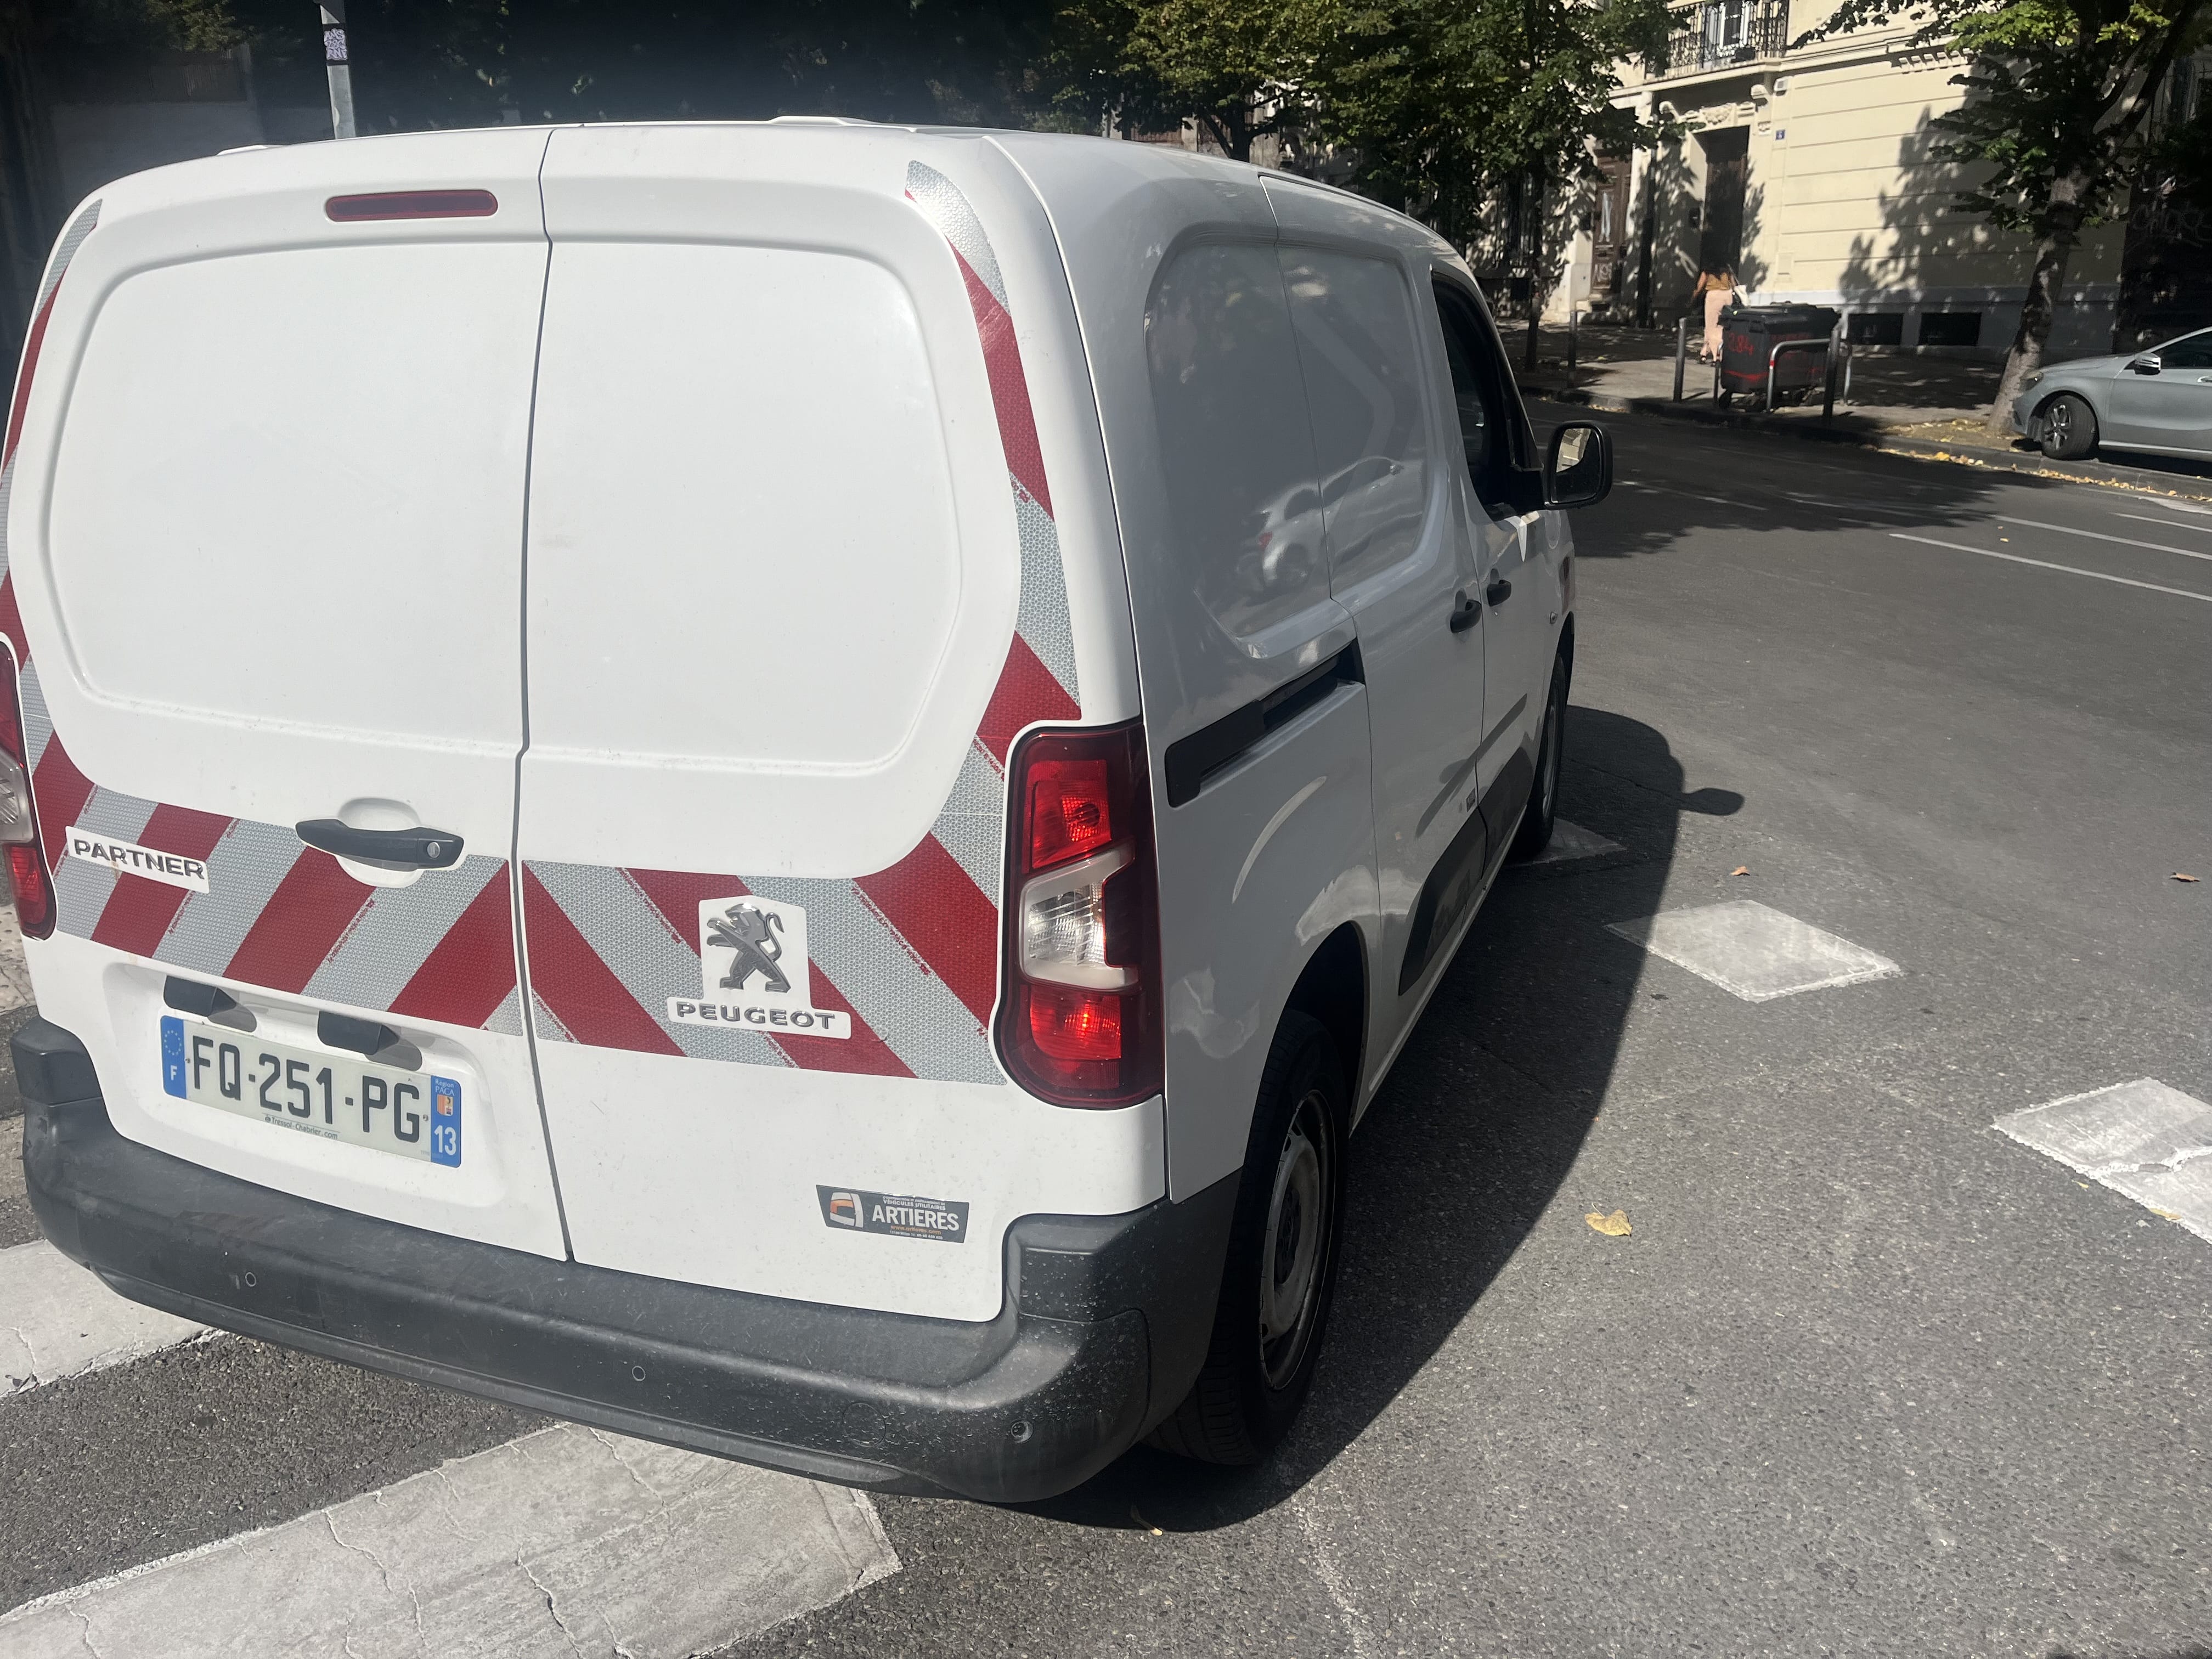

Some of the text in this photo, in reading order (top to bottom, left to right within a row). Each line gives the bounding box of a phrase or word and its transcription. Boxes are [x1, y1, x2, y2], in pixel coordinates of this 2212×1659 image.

[74, 839, 205, 880] PARTNER
[676, 1001, 835, 1029] PEUGEOT
[170, 1065, 178, 1081] F
[193, 1035, 420, 1143] FQ-251-PG
[435, 1086, 455, 1096] PACA
[434, 1125, 457, 1156] 13
[872, 1205, 960, 1231] ARTIERES
